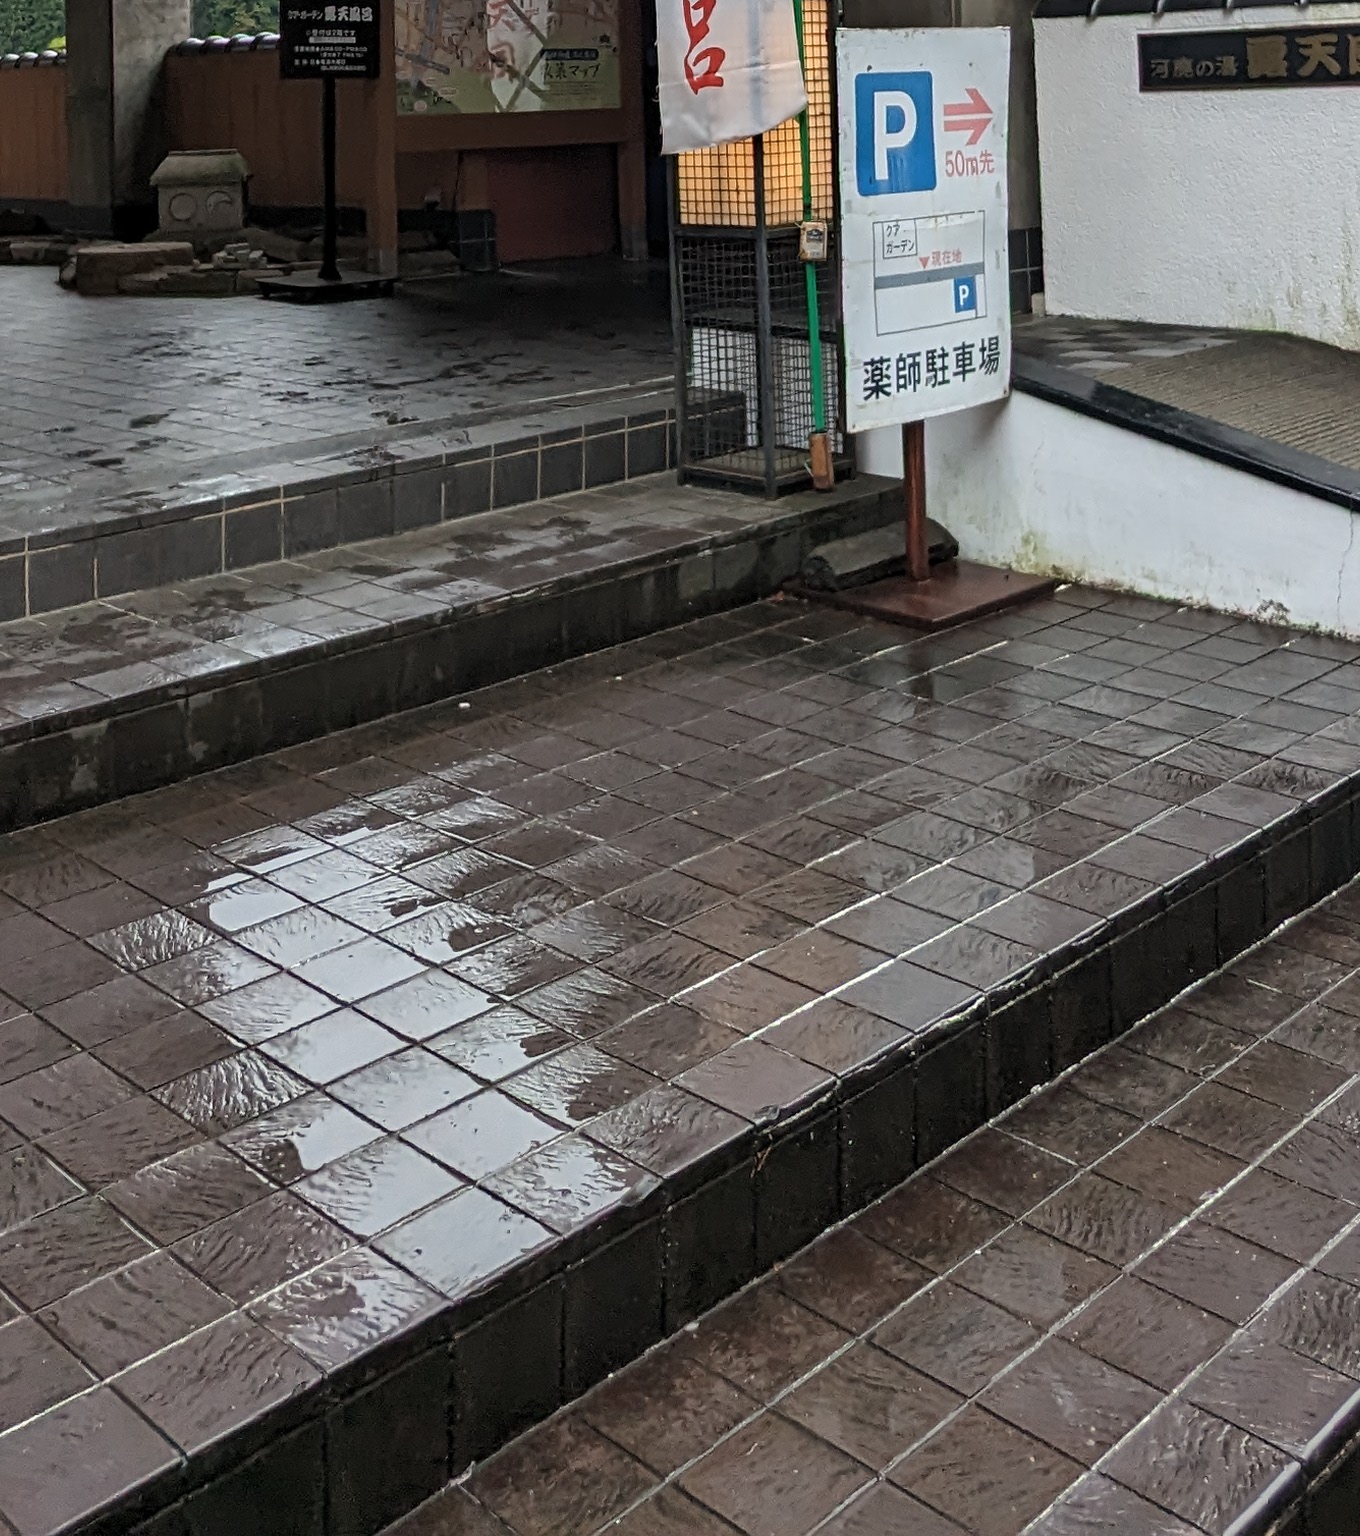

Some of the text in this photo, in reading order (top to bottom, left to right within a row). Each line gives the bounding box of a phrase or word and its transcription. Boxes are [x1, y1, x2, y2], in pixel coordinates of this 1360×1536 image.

[873, 90, 918, 181] P
[945, 149, 995, 178] 50m先
[885, 238, 916, 255] ガーデン
[931, 247, 963, 266] 現在地
[958, 284, 970, 307] P
[862, 335, 1001, 402] 薬師駐車場
